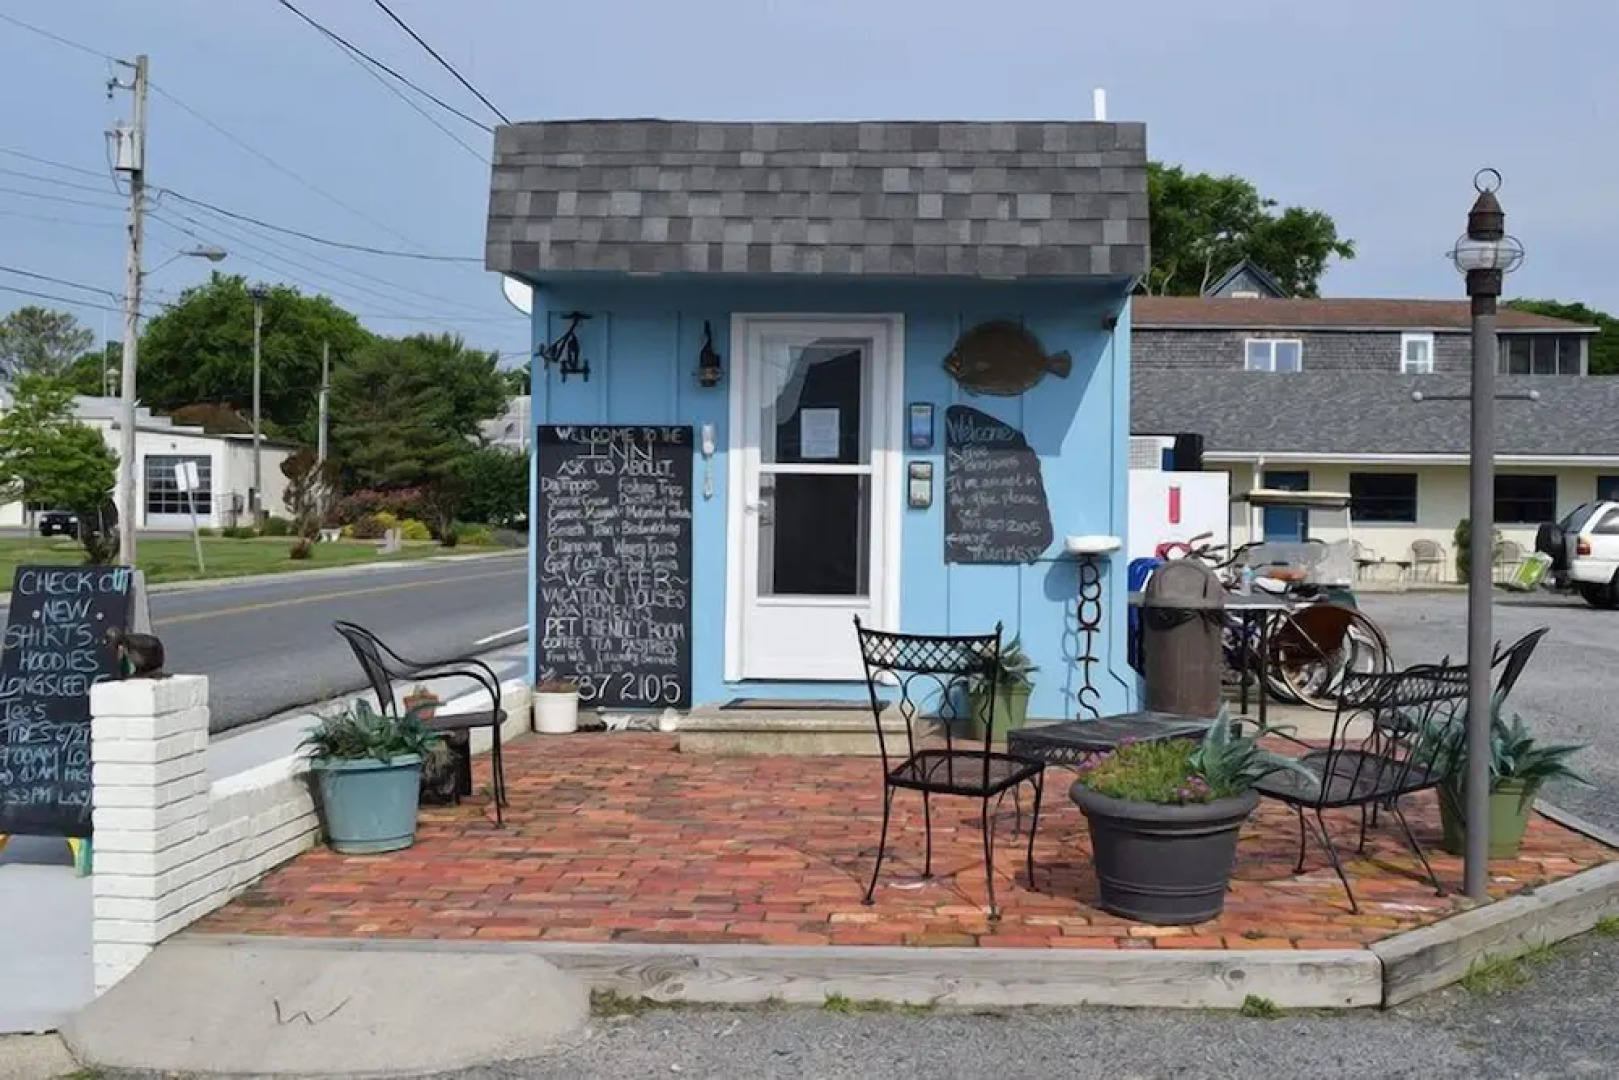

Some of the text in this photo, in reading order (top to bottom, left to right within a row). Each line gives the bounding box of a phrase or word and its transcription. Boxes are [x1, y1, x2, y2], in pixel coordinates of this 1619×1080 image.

[577, 441, 654, 462] INN
[557, 460, 586, 475] ASK
[594, 460, 615, 475] US
[20, 570, 93, 595] CHECK
[604, 569, 671, 588] OFFER
[541, 587, 686, 609] VACATION HOUSES
[42, 597, 92, 624] NEW
[545, 617, 578, 636] PET
[19, 649, 100, 672] HOODIES
[620, 672, 681, 703] 2105
